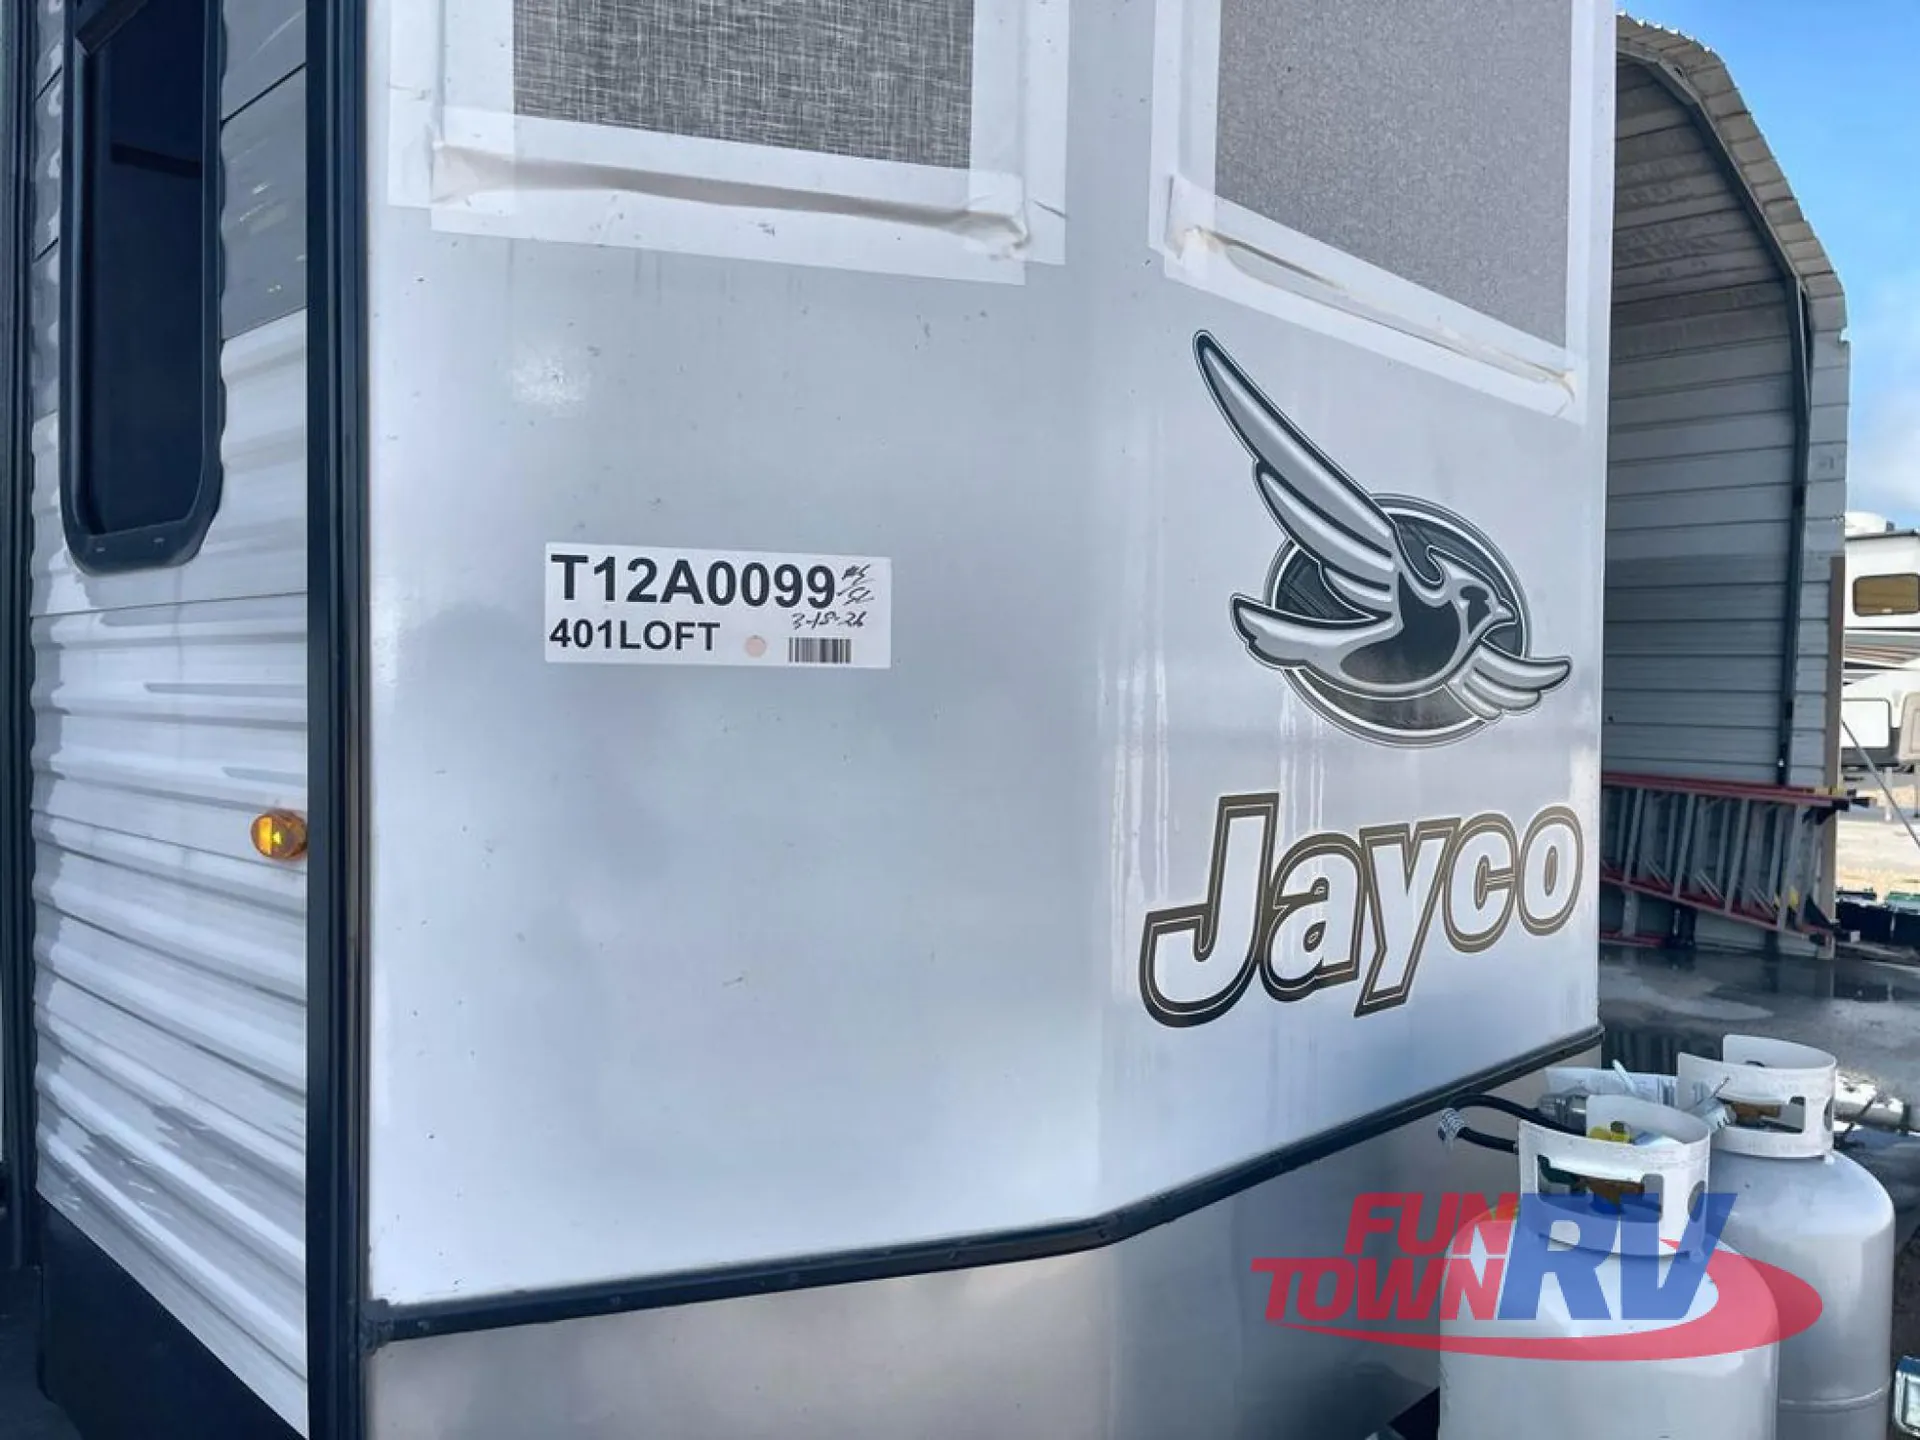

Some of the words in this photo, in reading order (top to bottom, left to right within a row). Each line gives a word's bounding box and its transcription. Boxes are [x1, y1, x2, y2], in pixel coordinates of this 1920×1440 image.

[550, 553, 835, 609] T12A0099
[549, 618, 720, 651] 401LOFT
[1139, 792, 1584, 1028] Jayco
